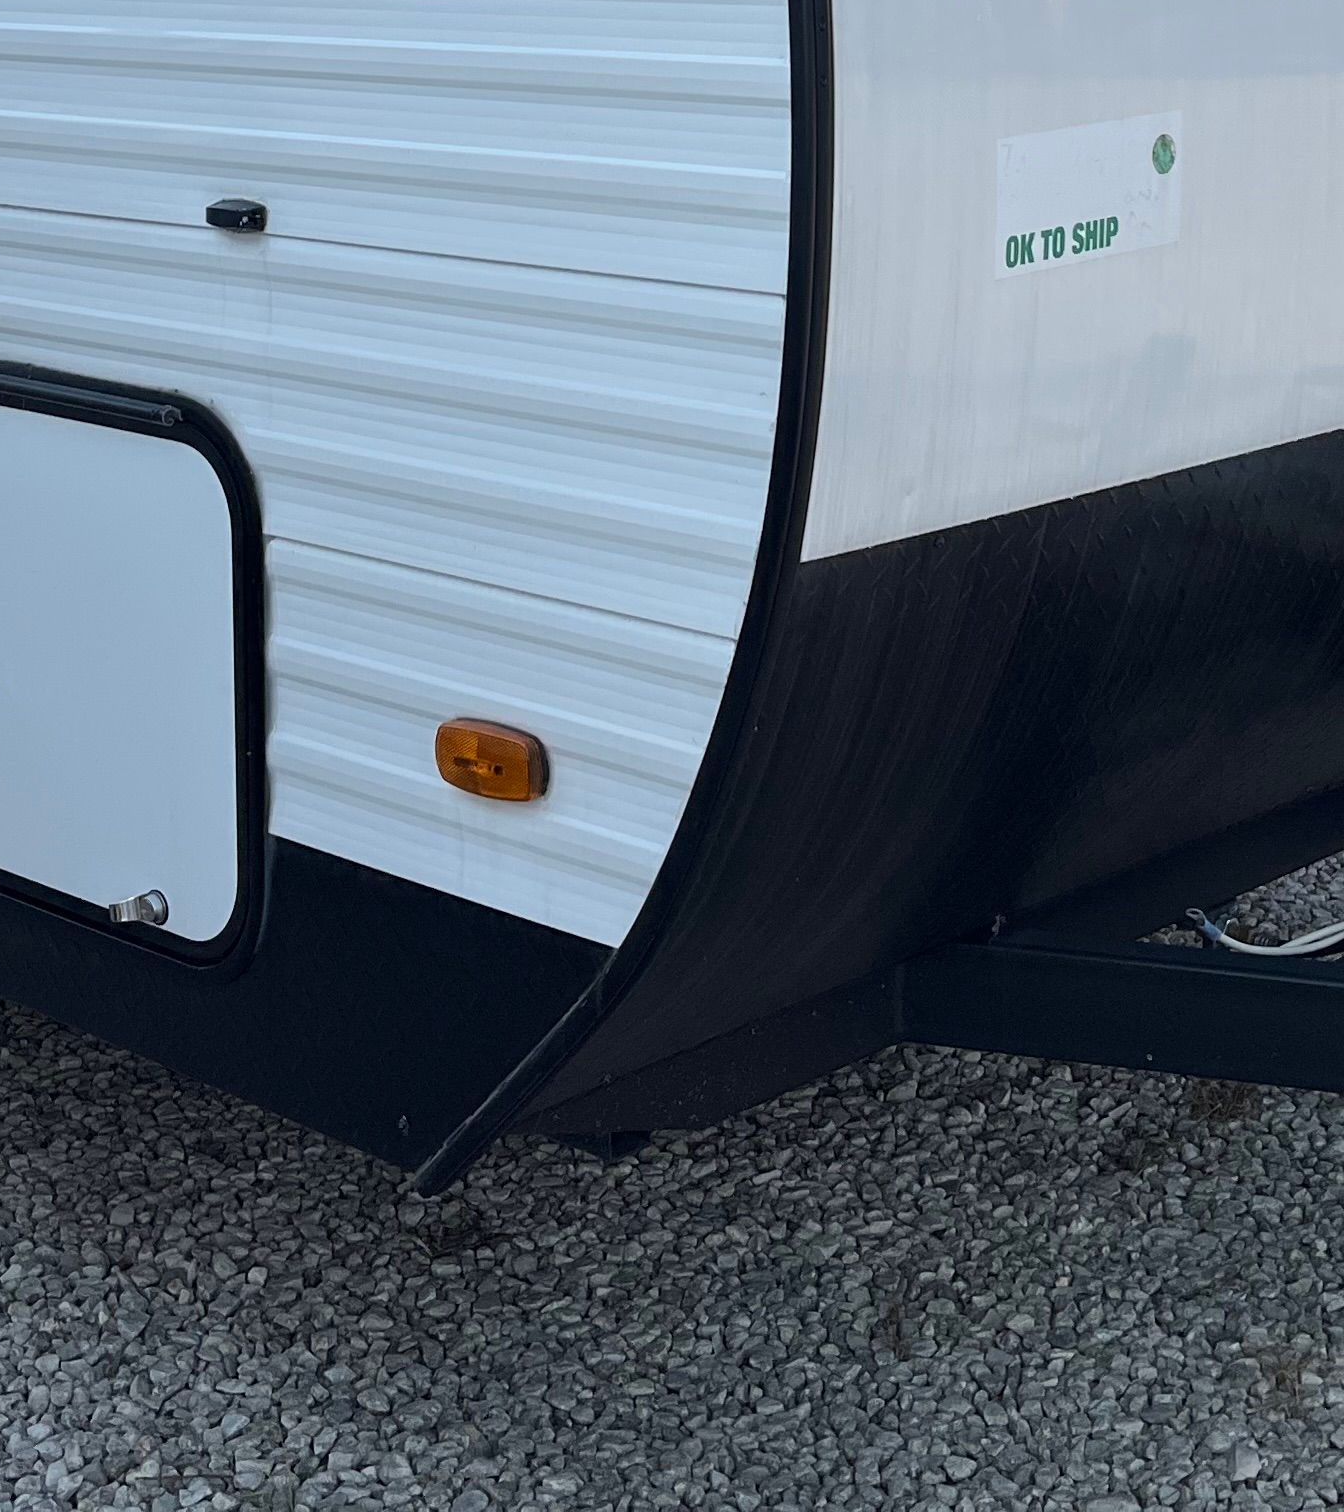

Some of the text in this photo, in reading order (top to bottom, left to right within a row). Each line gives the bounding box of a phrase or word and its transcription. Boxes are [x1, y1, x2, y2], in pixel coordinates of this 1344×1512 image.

[1006, 216, 1119, 268] OK TO SHIP
